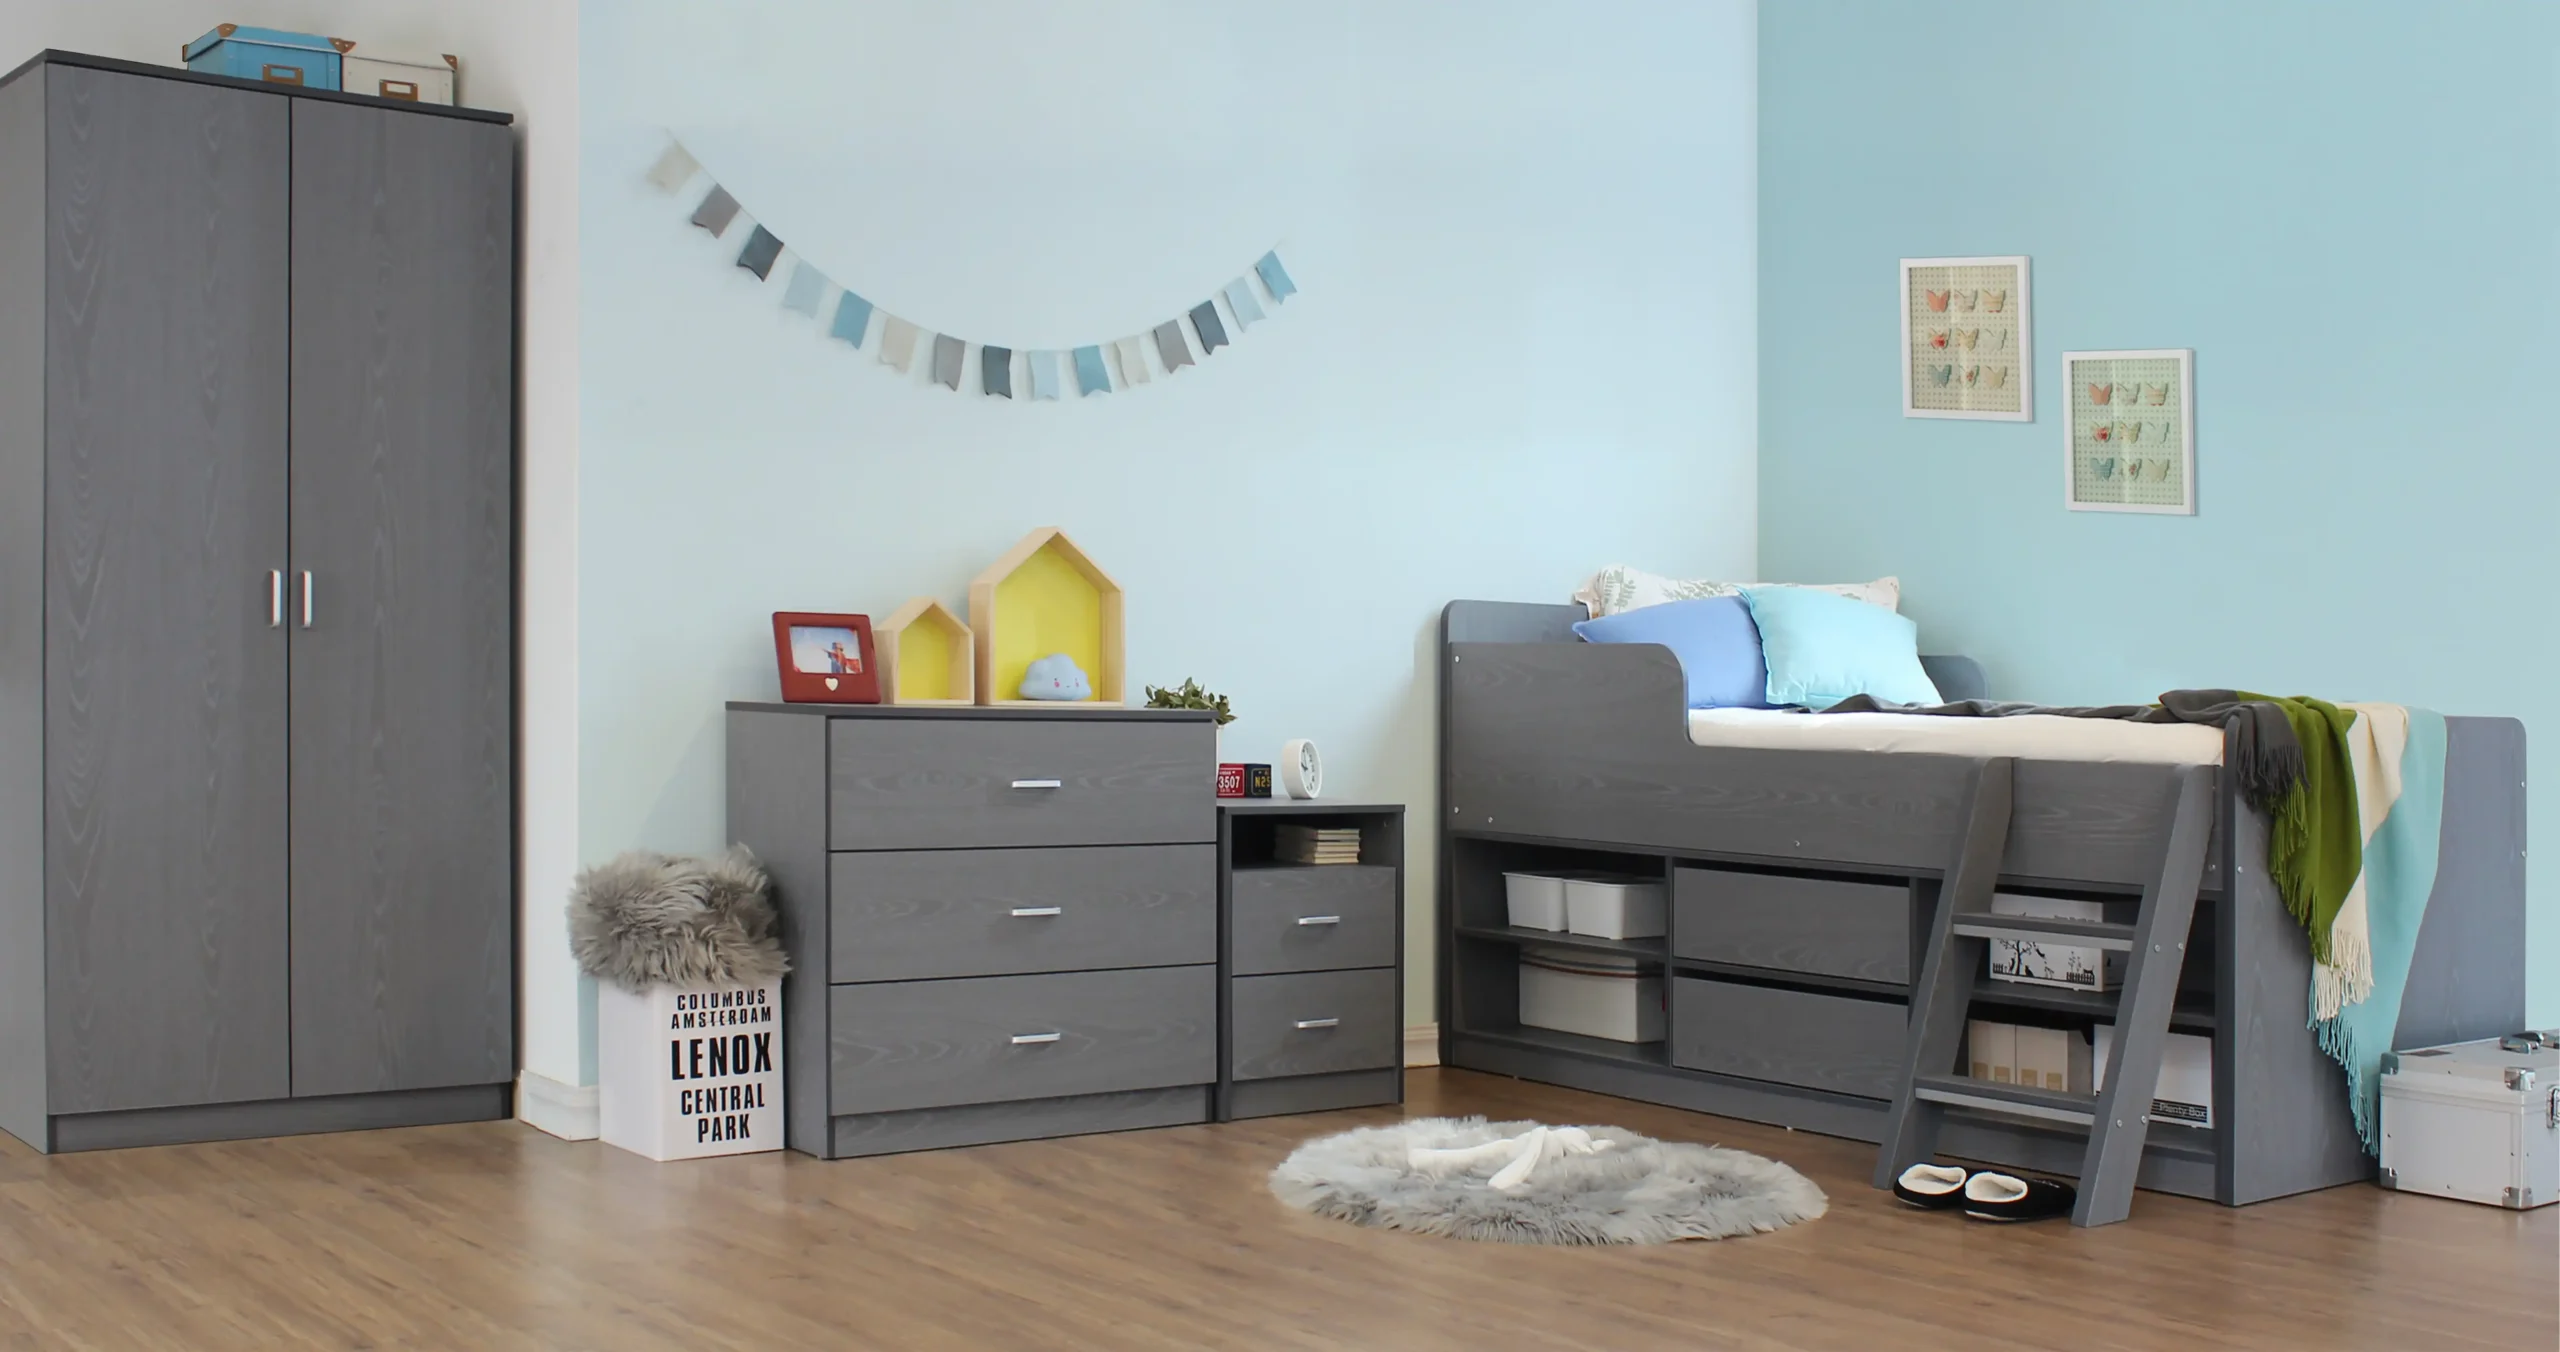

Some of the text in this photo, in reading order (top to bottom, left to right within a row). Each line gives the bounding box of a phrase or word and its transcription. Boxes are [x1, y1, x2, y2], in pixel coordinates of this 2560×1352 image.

[1218, 775, 1240, 789] 3507
[677, 988, 766, 1011] COLUMBUS
[671, 1006, 771, 1030] AMSTERDAM
[671, 1032, 772, 1081] LENOX
[681, 1083, 766, 1116] CENTRAL
[2188, 1107, 2206, 1118] Box
[697, 1113, 751, 1144] PARK
